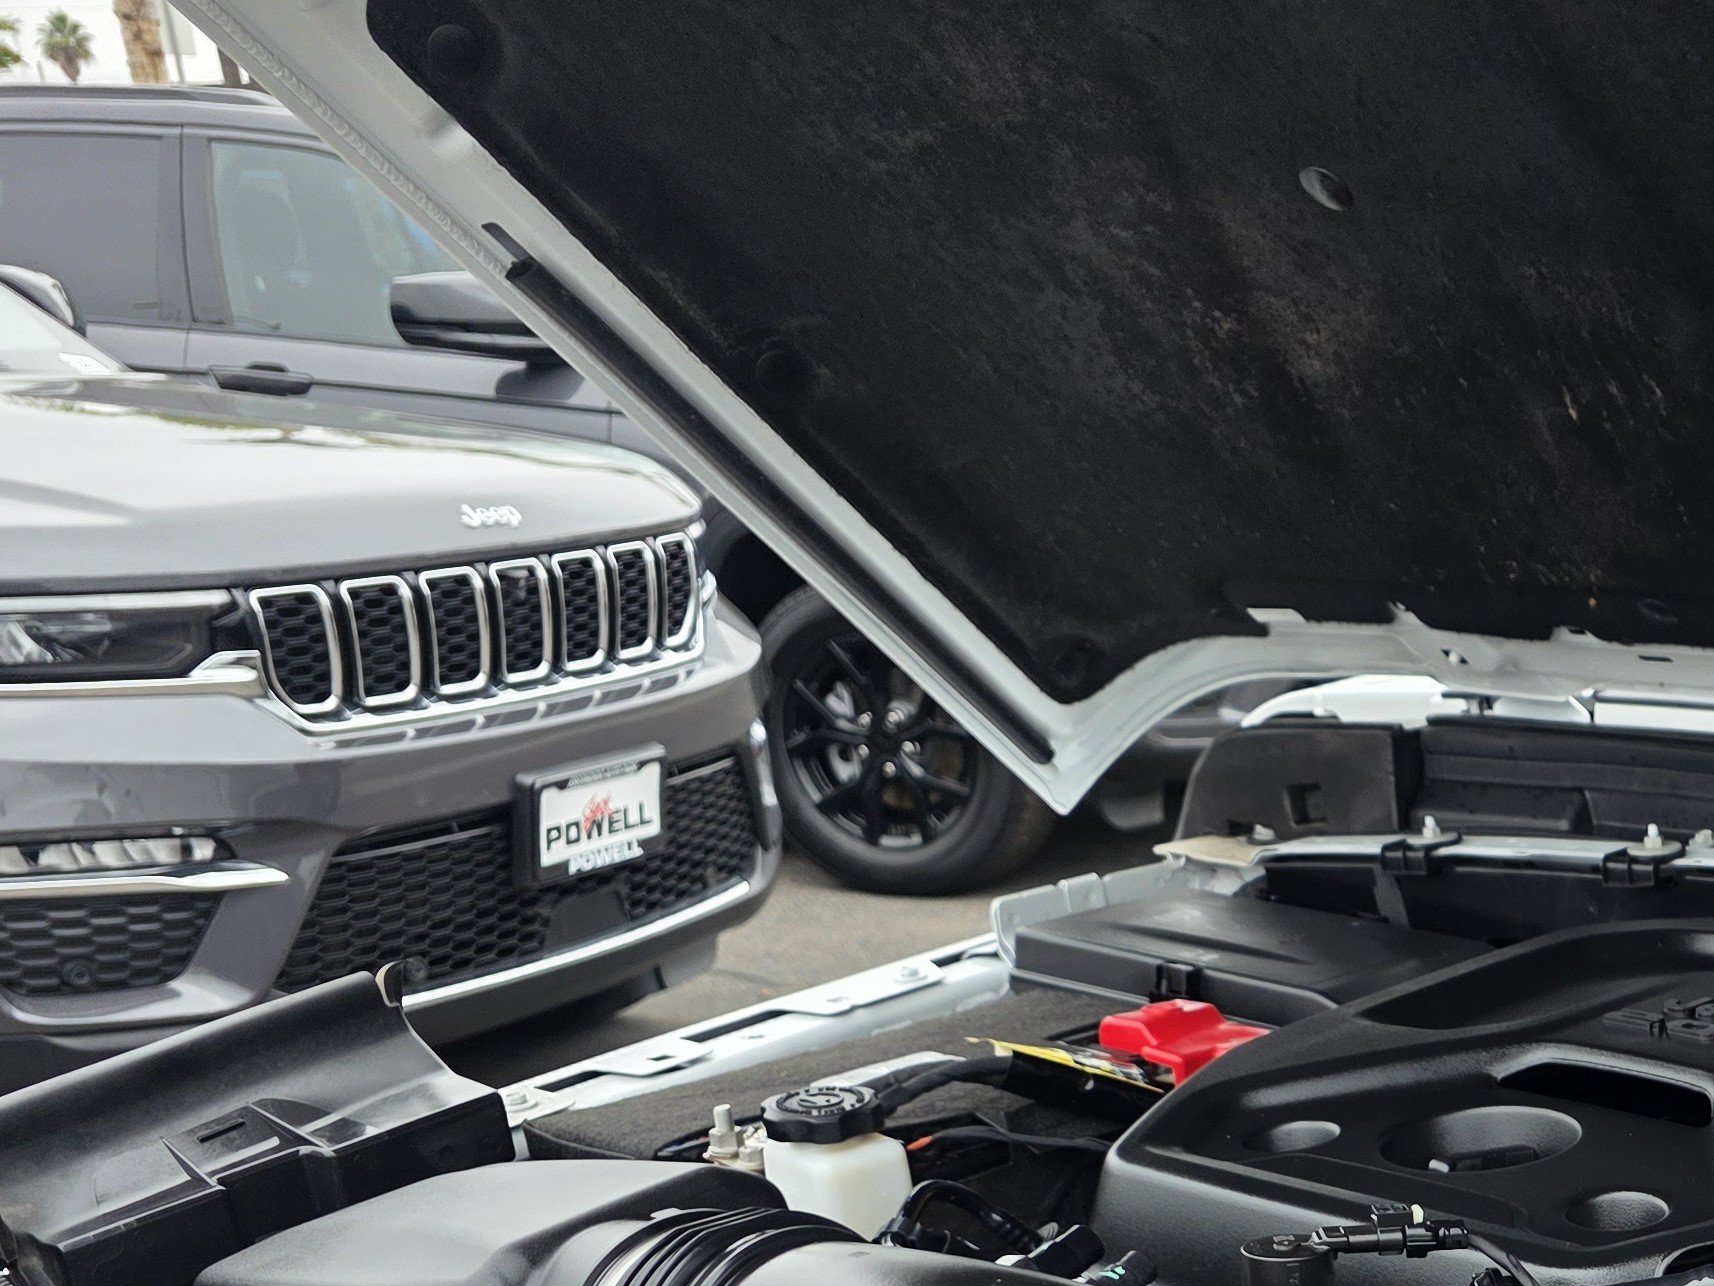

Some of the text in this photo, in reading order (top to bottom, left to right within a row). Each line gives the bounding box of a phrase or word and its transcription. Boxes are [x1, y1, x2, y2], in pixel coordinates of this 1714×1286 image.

[459, 503, 522, 528] Jeep
[546, 800, 655, 853] POWELL
[568, 839, 645, 875] POWELL
